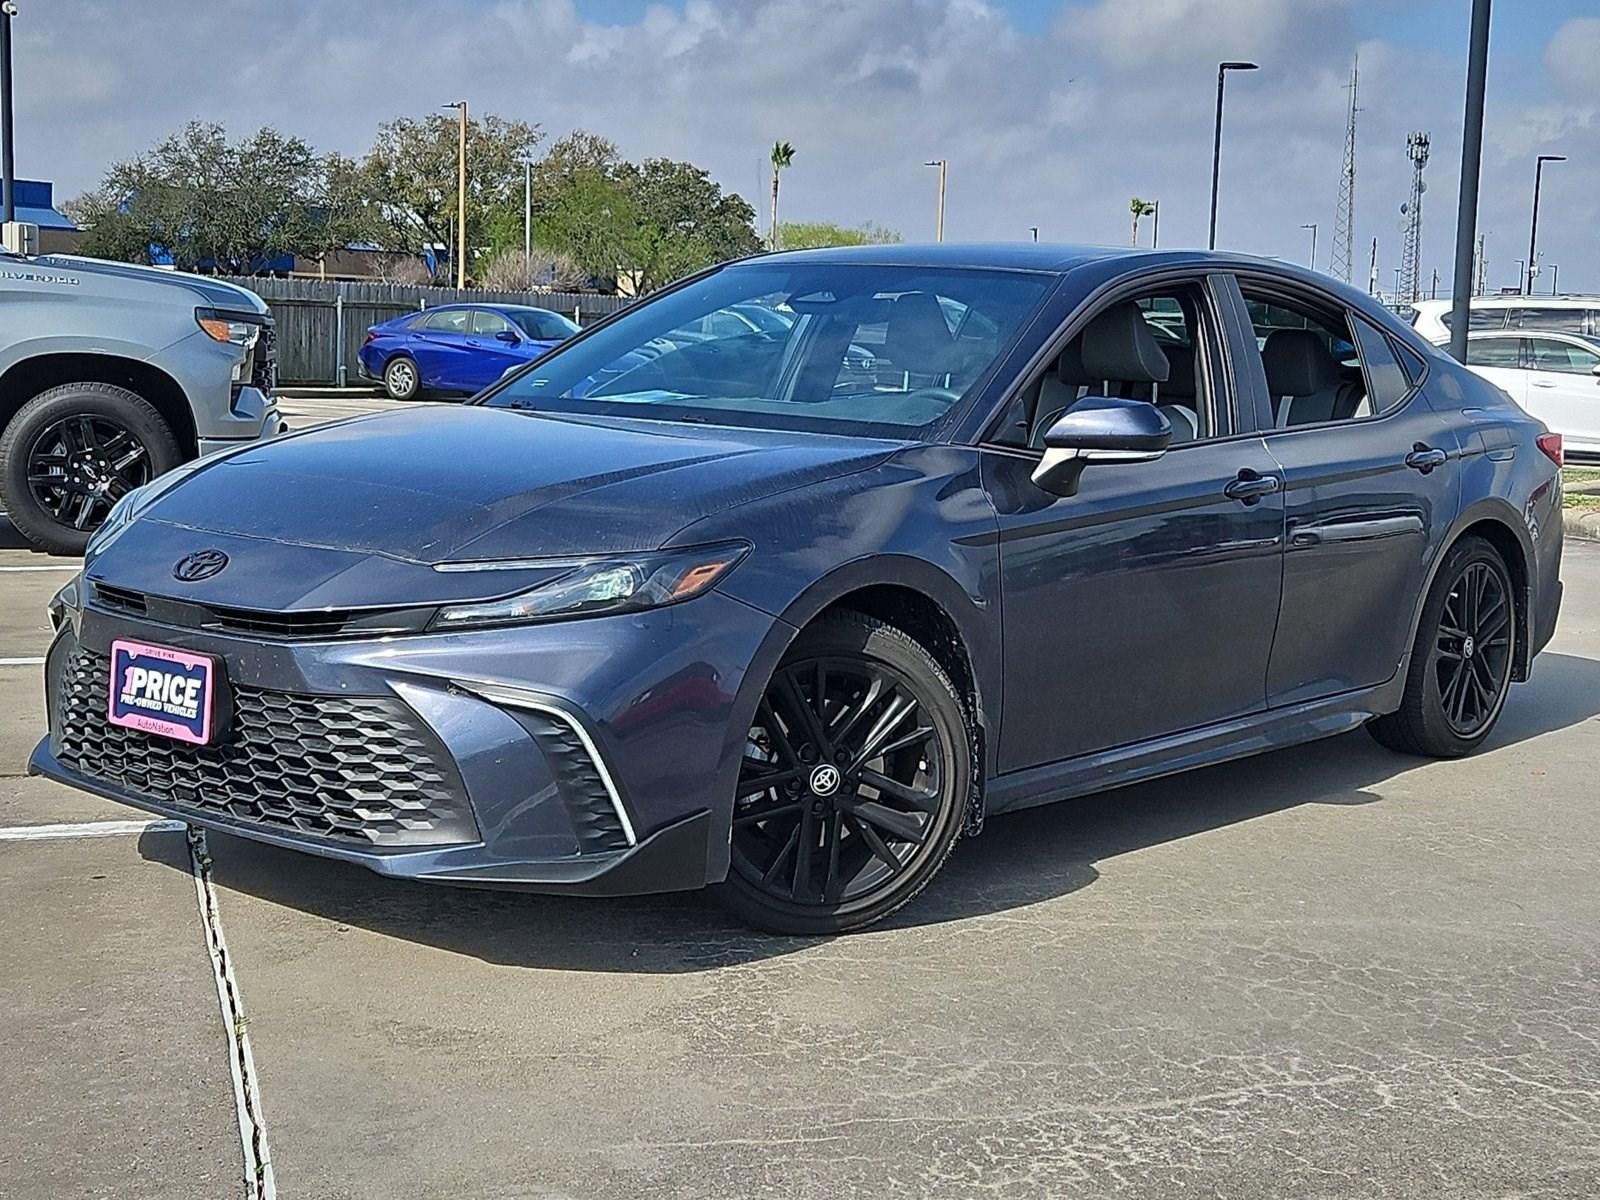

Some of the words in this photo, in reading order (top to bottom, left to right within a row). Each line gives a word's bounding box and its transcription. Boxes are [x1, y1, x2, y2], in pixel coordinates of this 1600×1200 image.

[0, 271, 80, 285] ILVERADO
[120, 694, 162, 711] PRE-OWNED
[163, 702, 197, 719] VEHICLES
[136, 719, 175, 735] AutoNation
